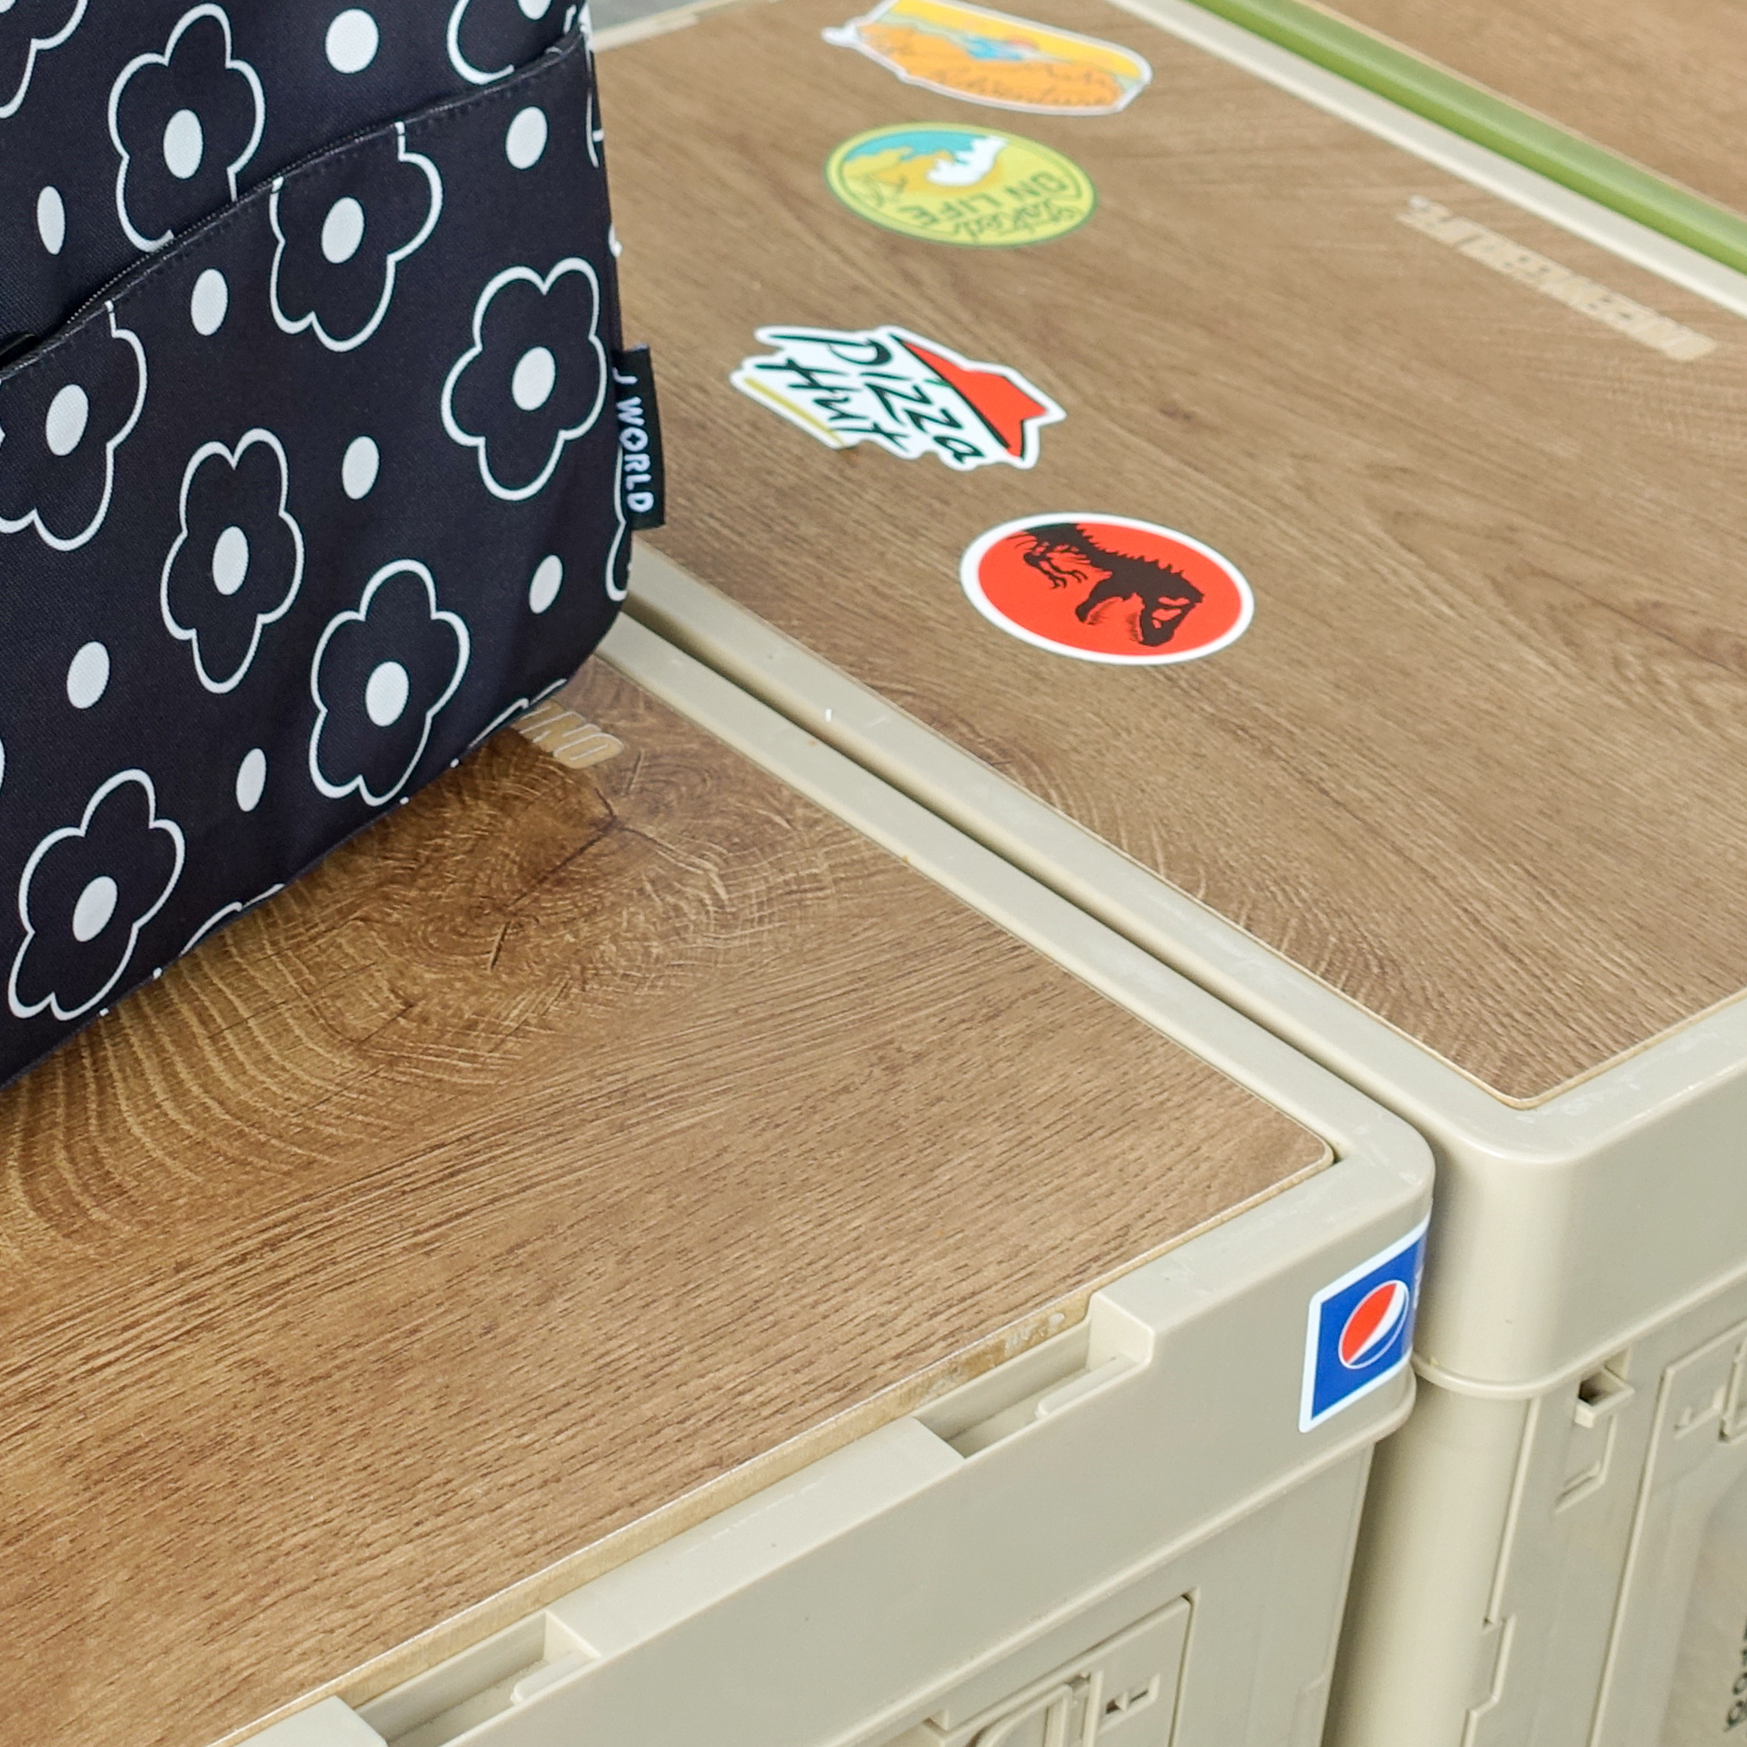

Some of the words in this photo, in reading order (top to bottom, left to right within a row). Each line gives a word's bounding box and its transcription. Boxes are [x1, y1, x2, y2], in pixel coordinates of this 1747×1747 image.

[898, 191, 1004, 227] LIFE
[611, 366, 639, 385] J
[754, 357, 913, 454] Hut
[767, 331, 986, 466] Pizza
[615, 395, 655, 513] WORLD
